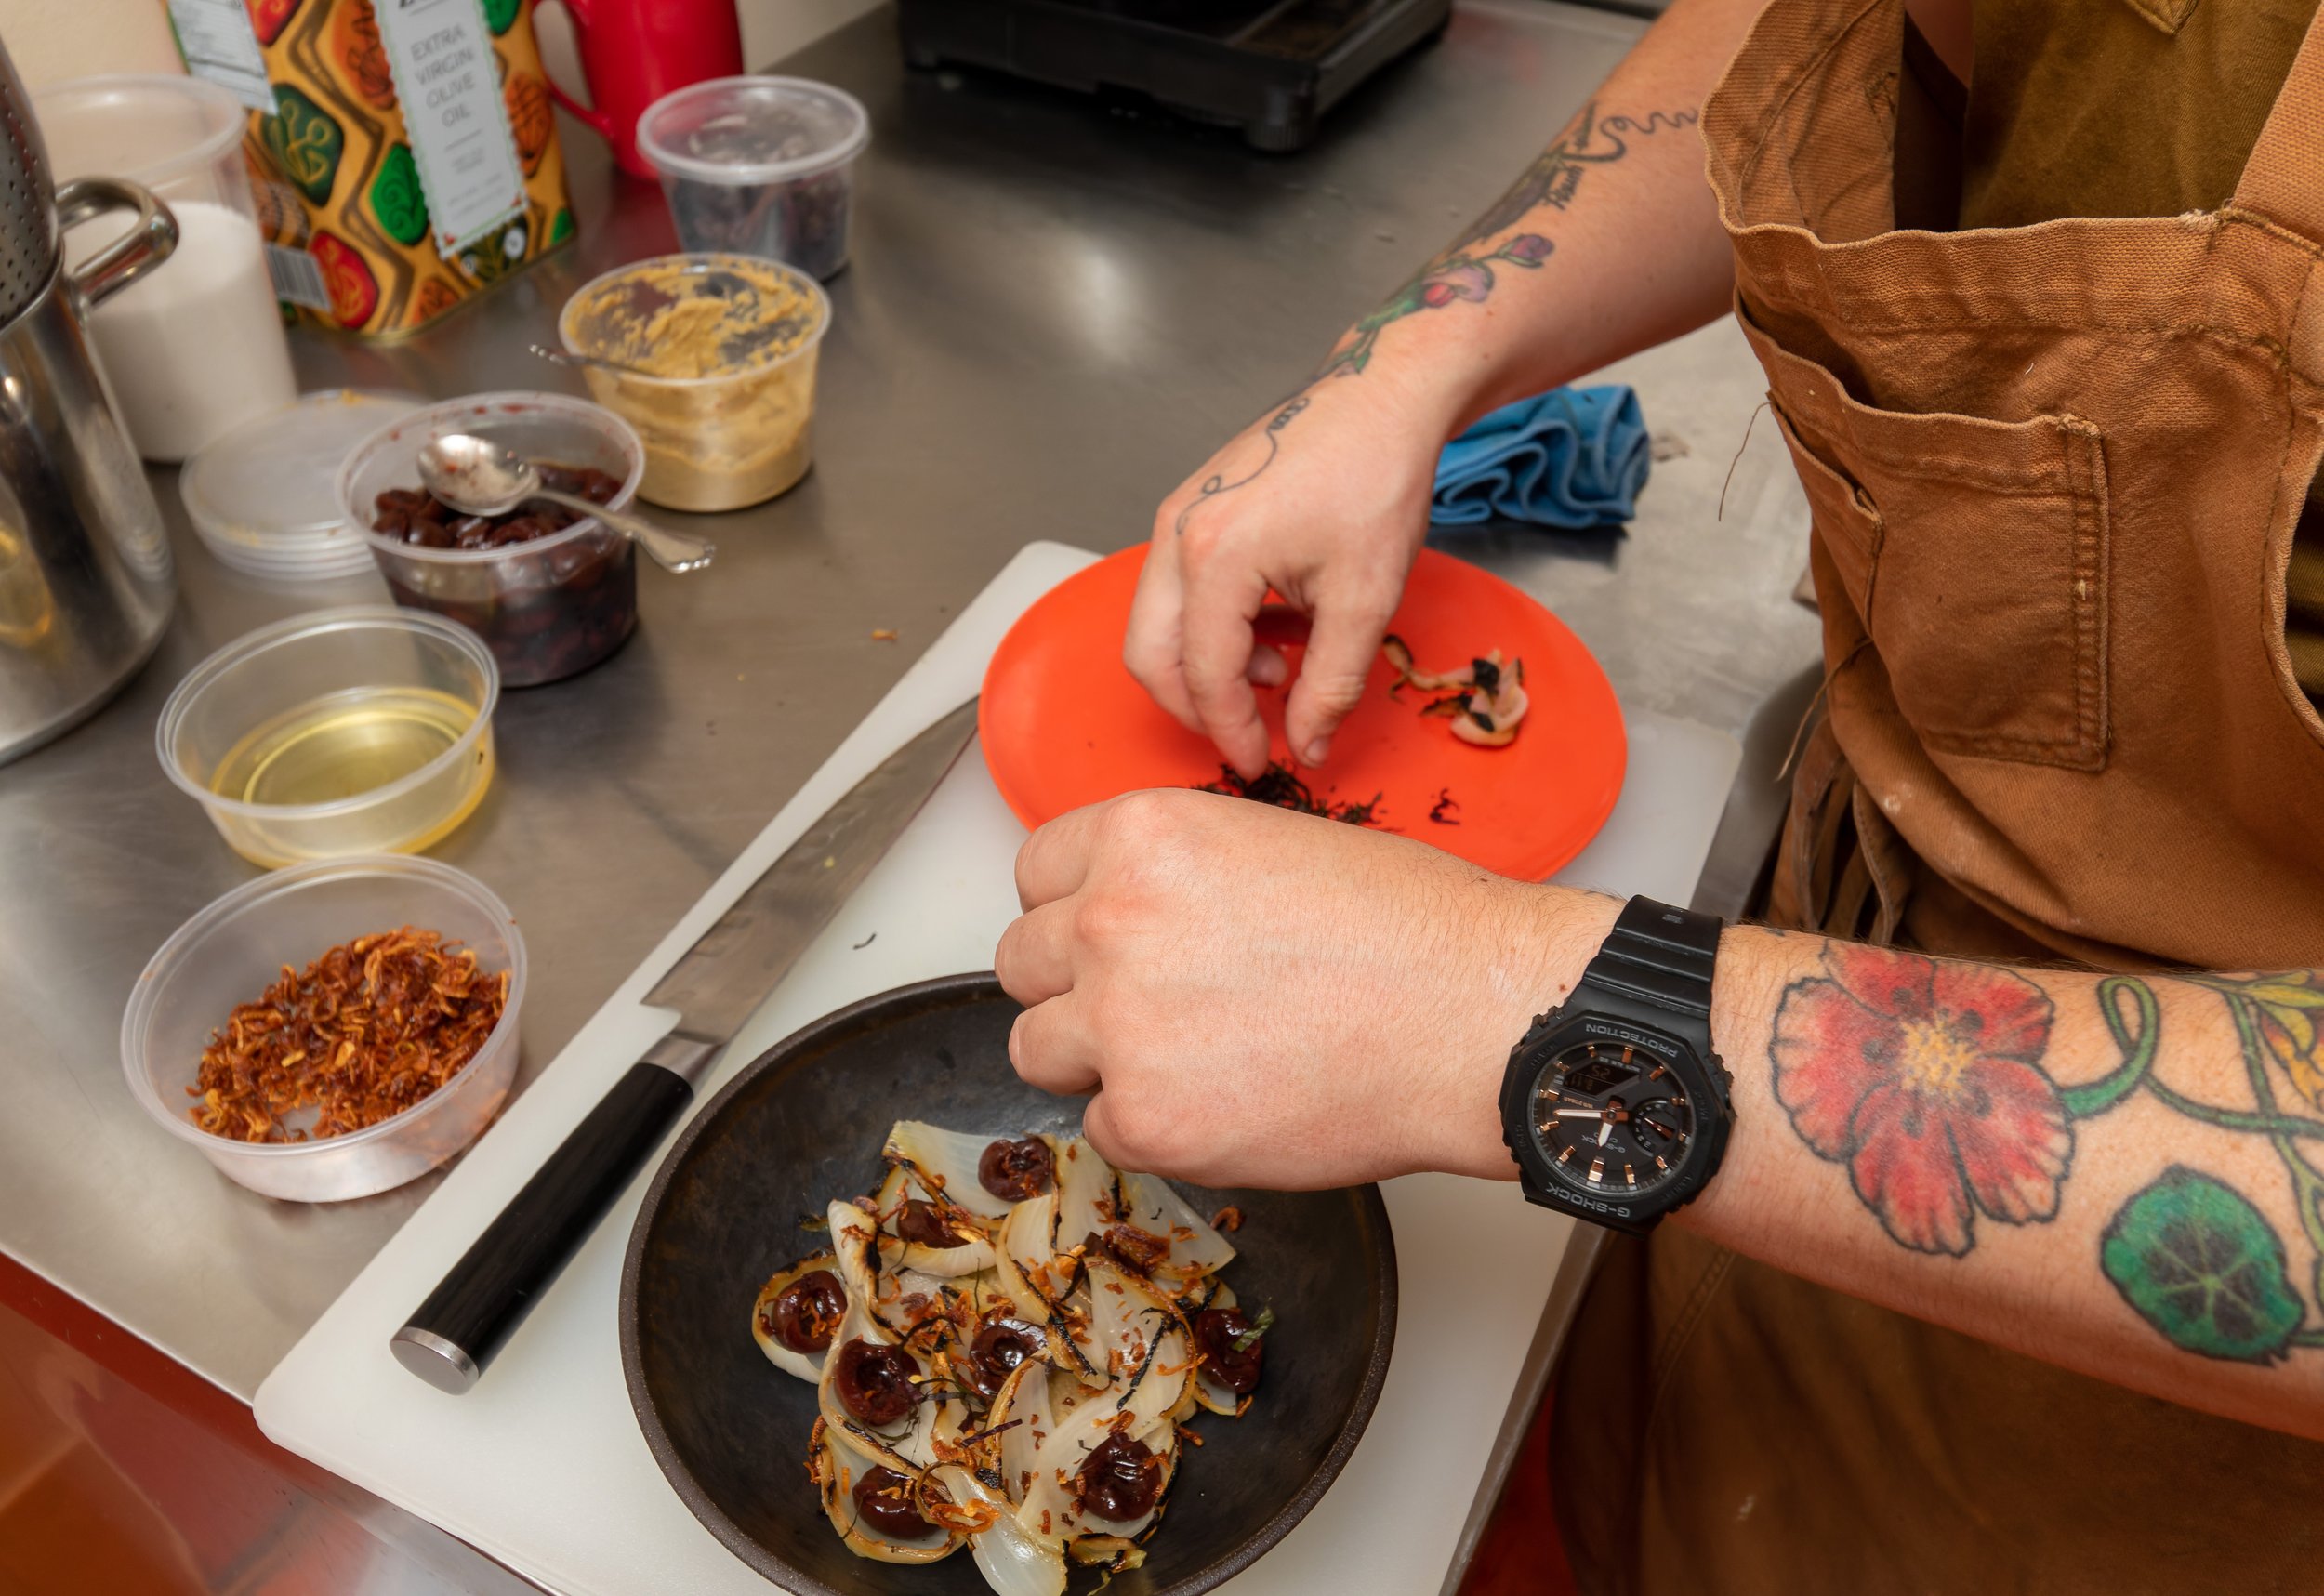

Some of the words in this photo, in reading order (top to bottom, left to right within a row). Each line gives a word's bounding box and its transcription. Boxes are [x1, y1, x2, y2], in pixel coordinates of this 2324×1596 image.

[410, 23, 466, 62] EXTRA
[415, 46, 475, 85] VIRGIN
[426, 72, 475, 109] OLIVE
[442, 103, 471, 127] OIL
[1585, 1023, 1678, 1058] PROTECTION
[1546, 1181, 1631, 1218] G-SHOCK
